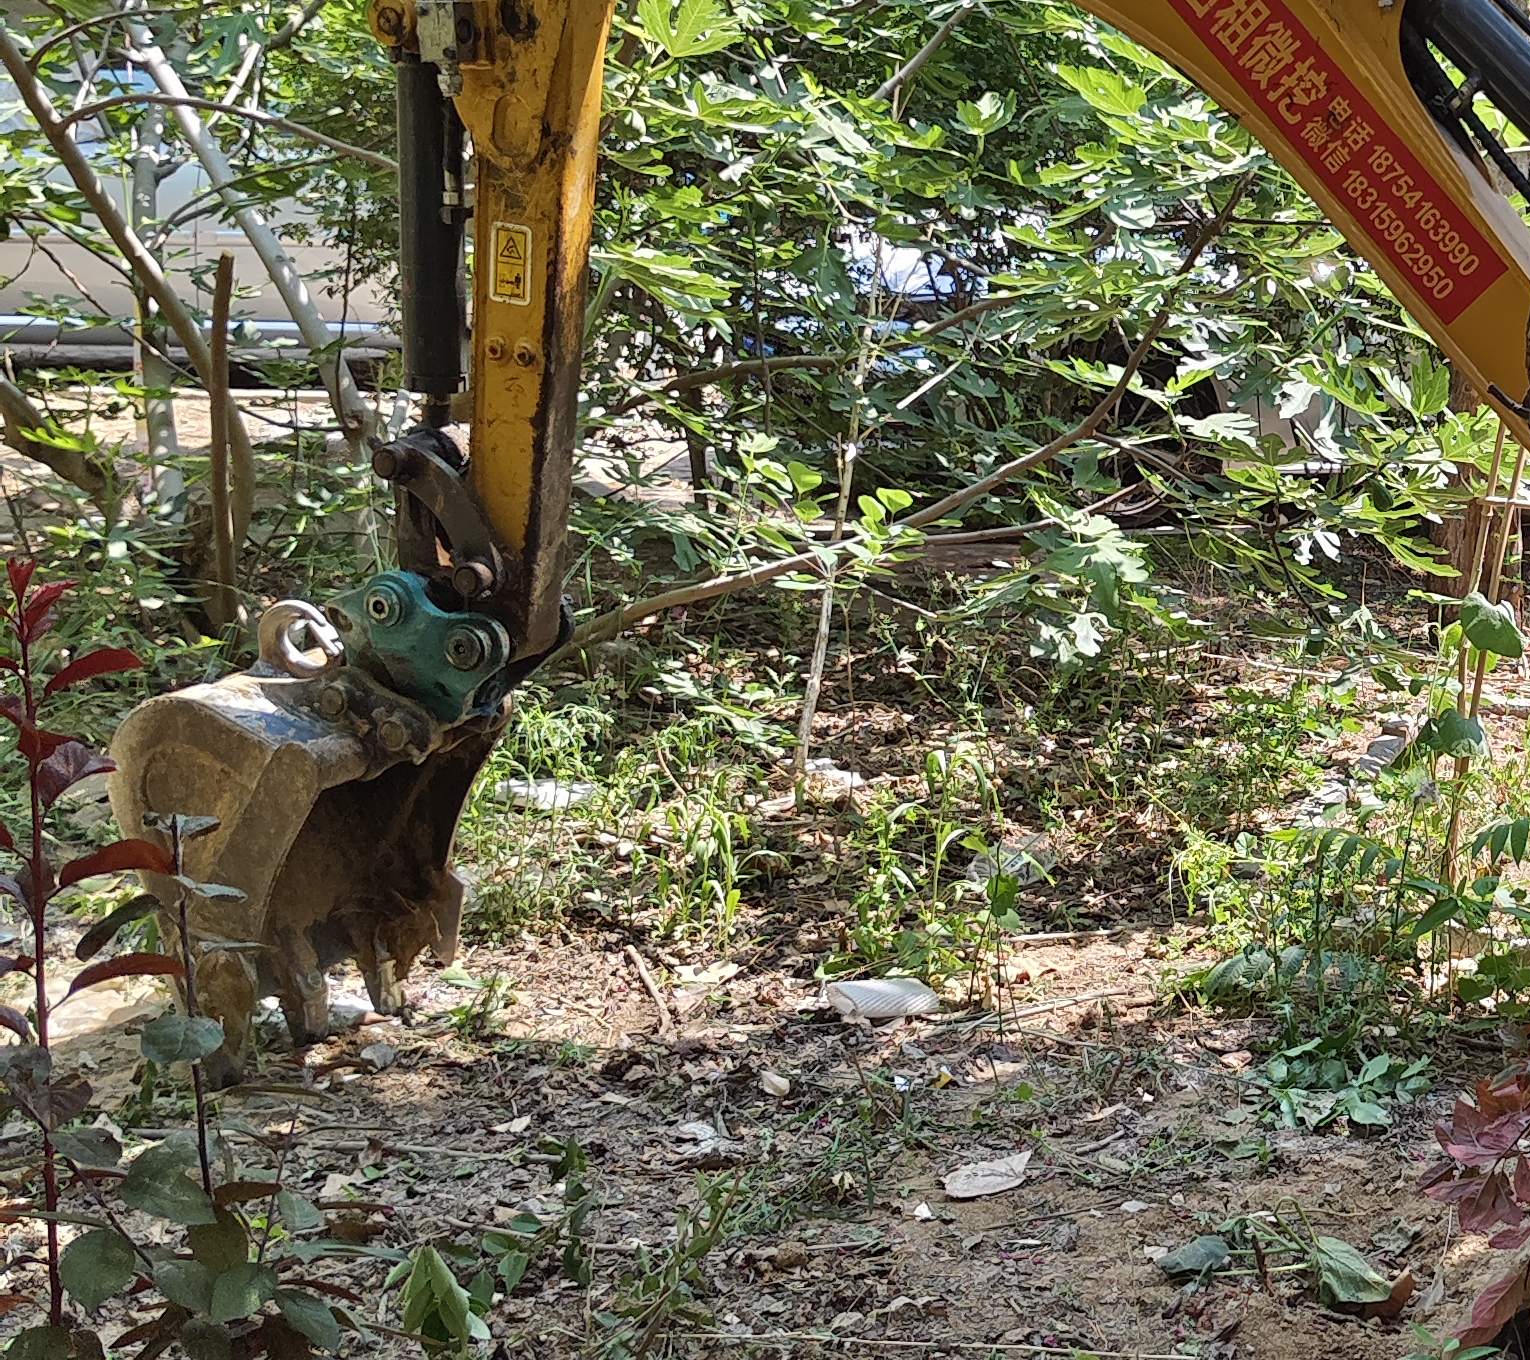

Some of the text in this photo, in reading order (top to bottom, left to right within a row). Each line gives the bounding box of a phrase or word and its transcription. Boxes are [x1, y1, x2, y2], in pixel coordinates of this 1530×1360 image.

[1300, 116, 1454, 299] 微信 18315962950
[1328, 96, 1480, 276] 电话 18754163990
